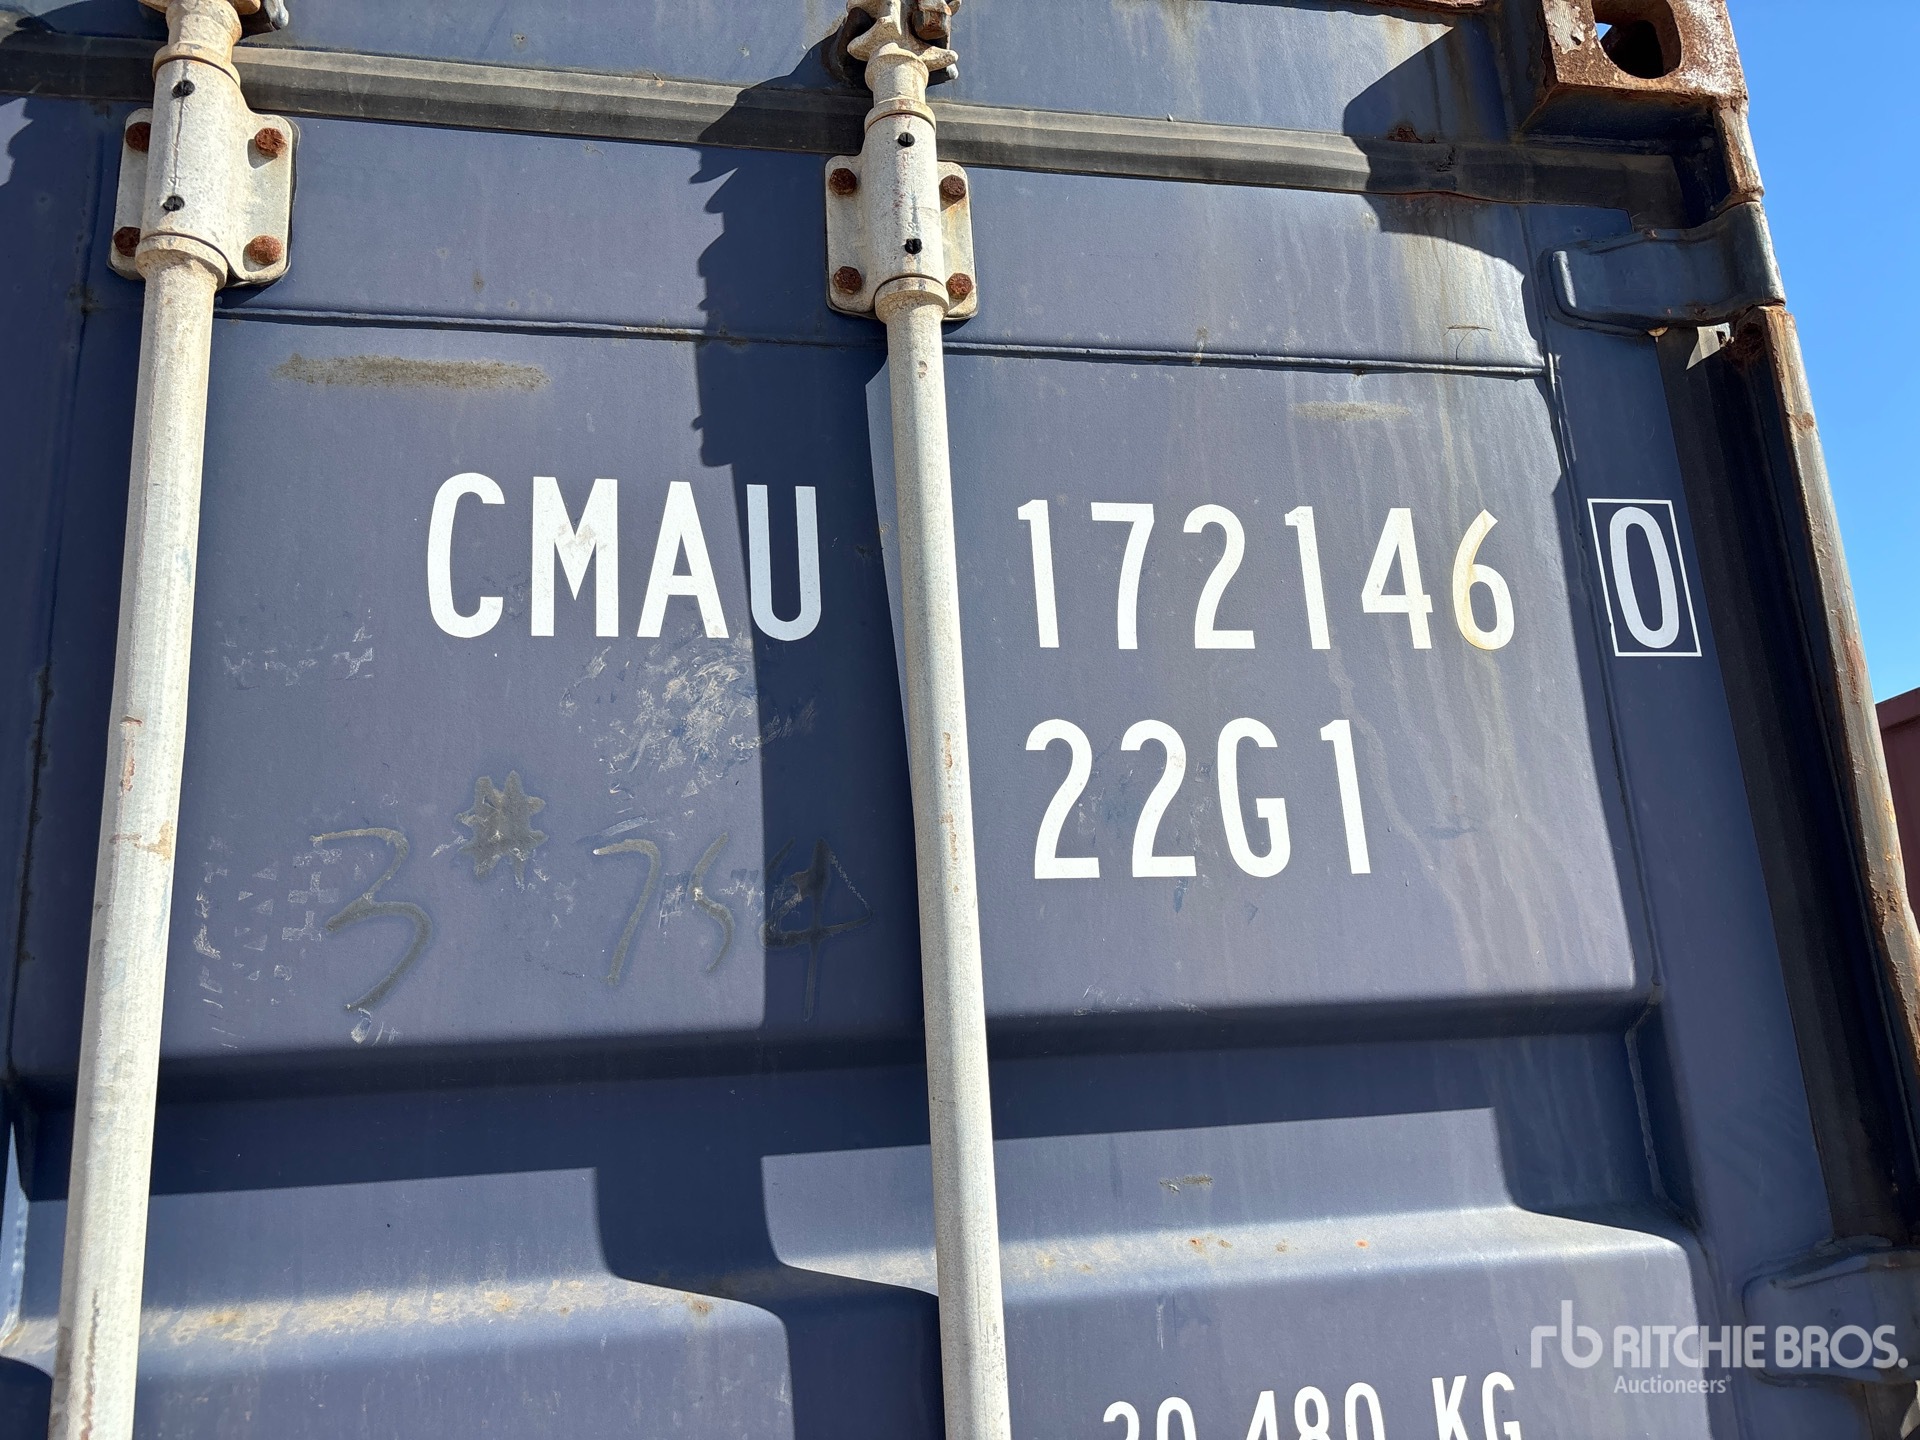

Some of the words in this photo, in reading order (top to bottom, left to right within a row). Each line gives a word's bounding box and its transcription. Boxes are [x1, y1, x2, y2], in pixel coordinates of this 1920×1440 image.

[427, 472, 821, 641] CMAU
[1017, 499, 1518, 651] 172146
[1610, 507, 1679, 648] 0
[1024, 717, 1371, 879] 22G1
[1431, 1372, 1522, 1440] KG
